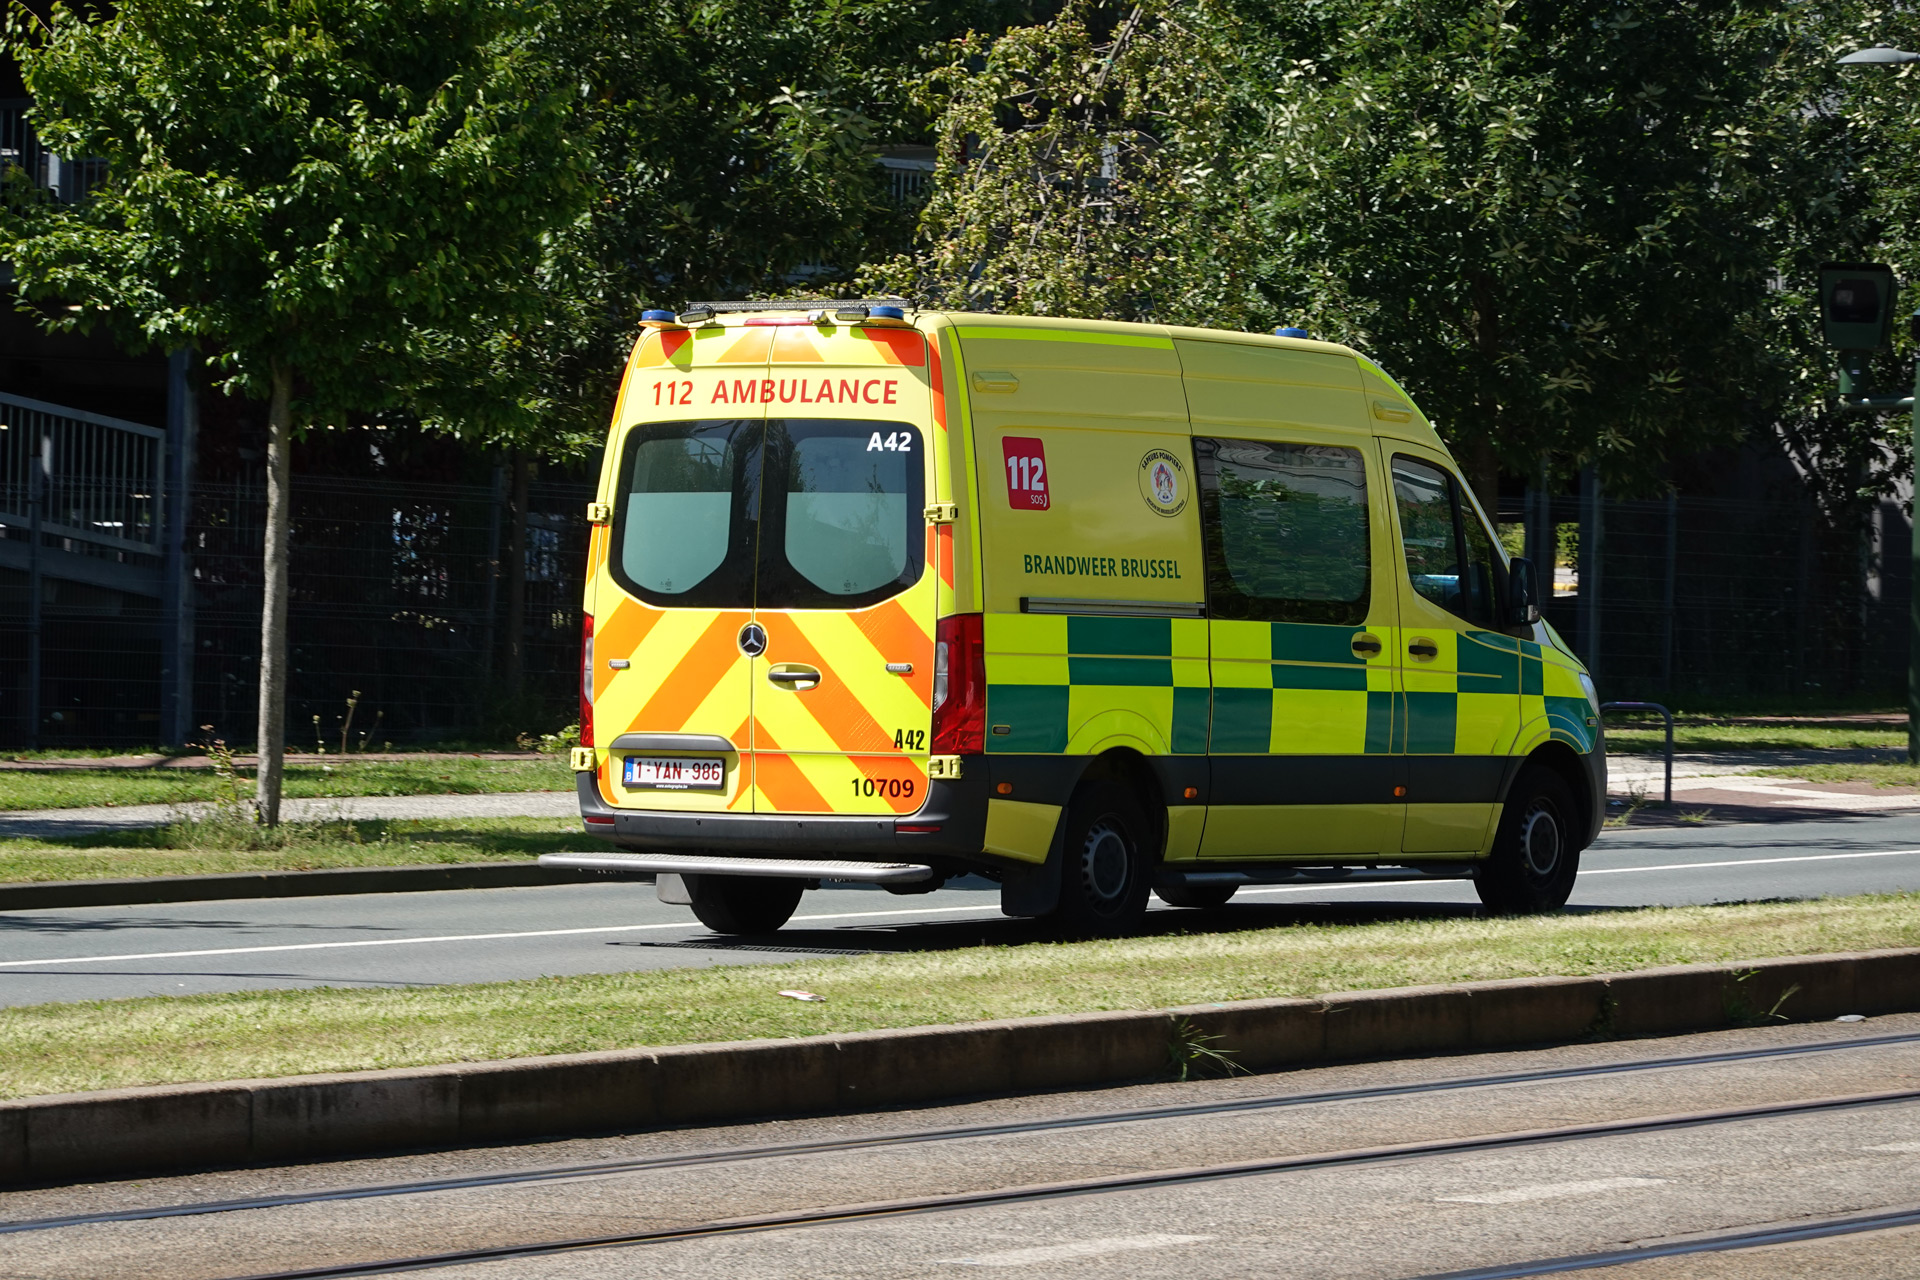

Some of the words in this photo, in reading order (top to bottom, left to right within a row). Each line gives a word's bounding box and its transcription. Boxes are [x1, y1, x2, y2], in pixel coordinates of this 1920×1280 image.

[652, 380, 694, 406] 112
[710, 379, 898, 405] AMBULANCE
[866, 431, 912, 452] A42
[1141, 452, 1159, 470] SAPEURS
[1159, 452, 1182, 471] POMPIERS
[1007, 455, 1045, 491] 112
[1030, 494, 1044, 505] SOS
[1023, 554, 1118, 577] BRANDWEER
[1121, 558, 1182, 579] BRUSSEL
[894, 728, 925, 750] A42
[626, 771, 632, 780] B
[636, 760, 720, 781] 1-YAN-986
[851, 778, 915, 798] 10709
